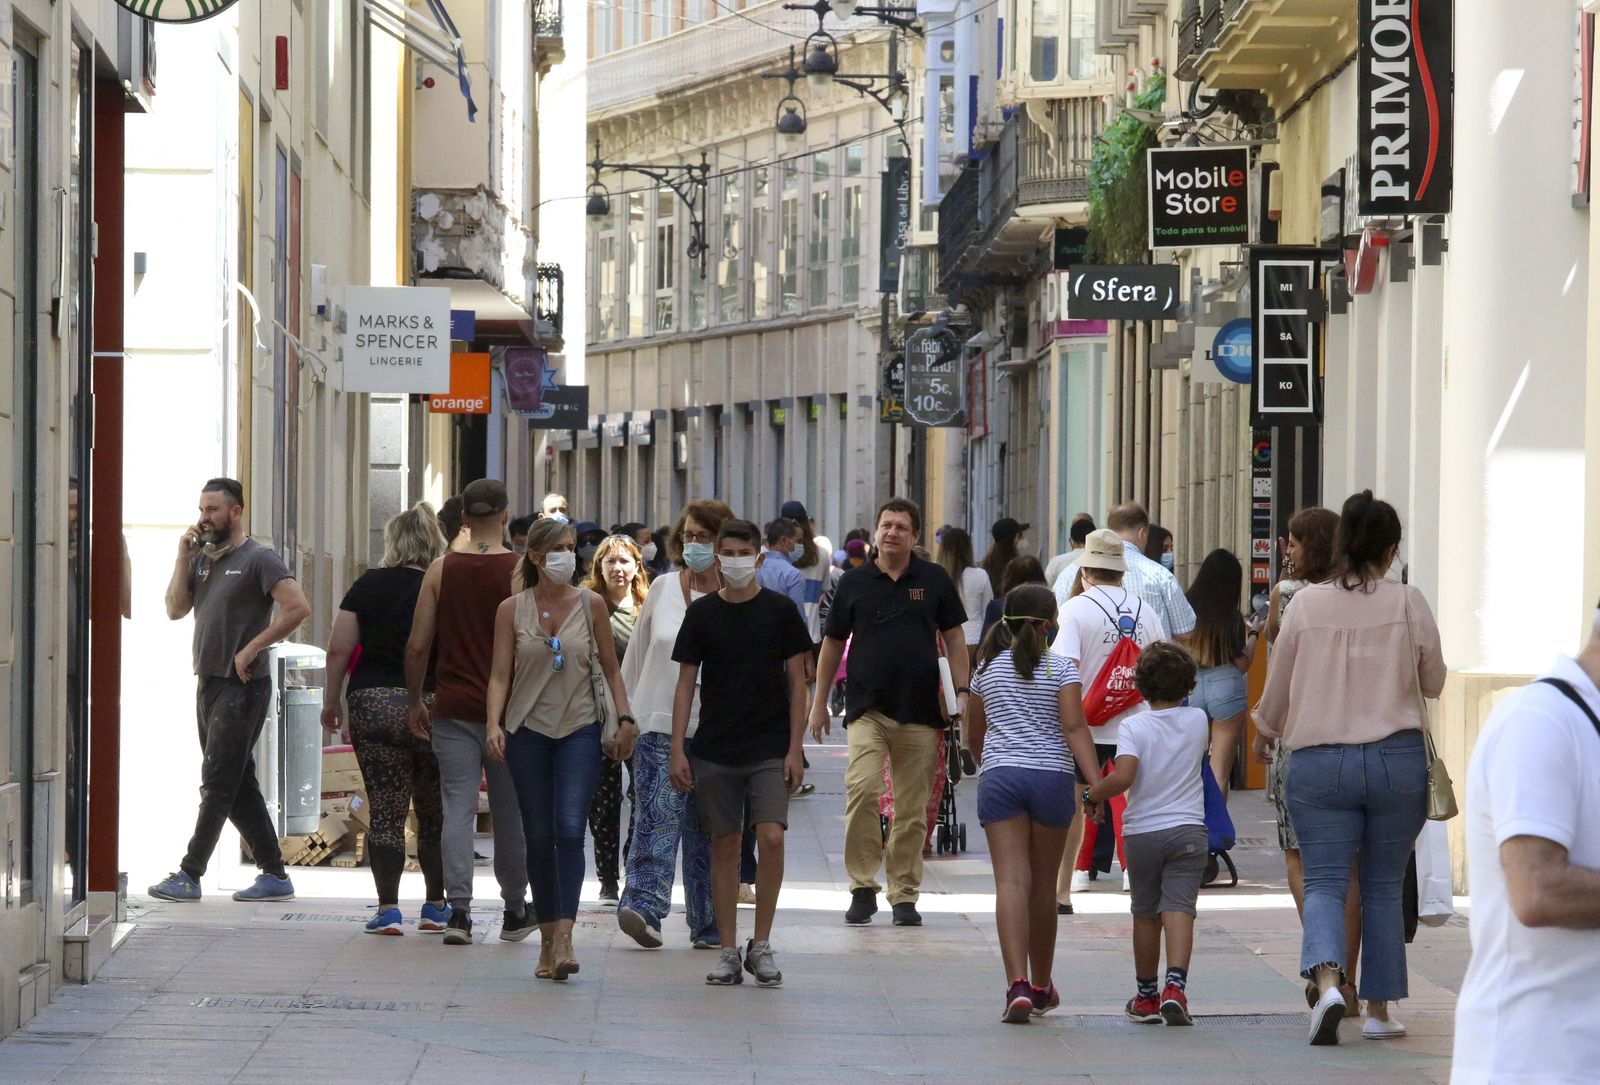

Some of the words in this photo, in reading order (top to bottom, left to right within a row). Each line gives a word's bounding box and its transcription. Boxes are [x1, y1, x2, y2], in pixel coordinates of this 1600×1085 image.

[1156, 166, 1245, 190] Mobile
[1165, 193, 1237, 215] Store
[899, 204, 909, 218] del
[895, 221, 908, 249] Casa
[1155, 226, 1179, 236] Todo
[1182, 226, 1204, 236] para
[1207, 225, 1217, 233] tu
[1220, 223, 1247, 233] móvil
[1280, 283, 1293, 292] MI
[360, 315, 419, 329] MARKS
[423, 316, 434, 329] &
[356, 334, 438, 349] SPENCER
[1280, 332, 1293, 341] SA
[370, 356, 423, 366] LINGERIE
[1280, 381, 1293, 390] KO
[432, 398, 484, 411] orange
